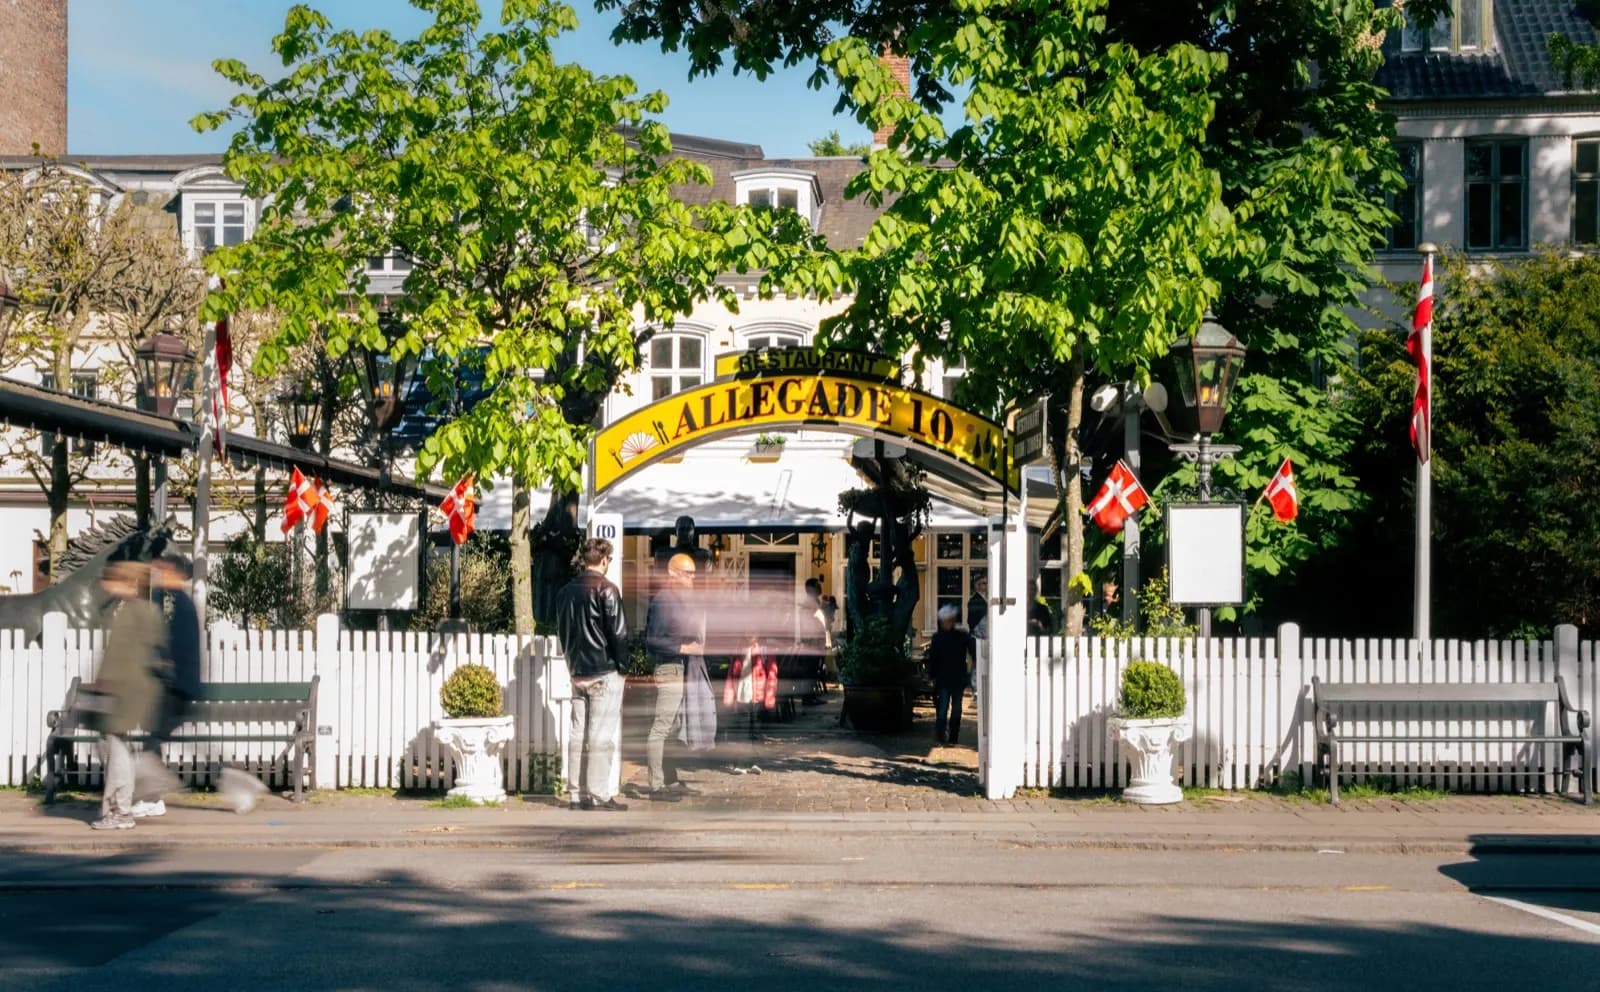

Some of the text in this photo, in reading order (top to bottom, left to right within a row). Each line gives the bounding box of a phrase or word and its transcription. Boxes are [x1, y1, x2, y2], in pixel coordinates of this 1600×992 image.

[739, 350, 878, 373] RESTAURANT
[672, 379, 893, 440] ALLEGADE
[908, 397, 953, 444] 10
